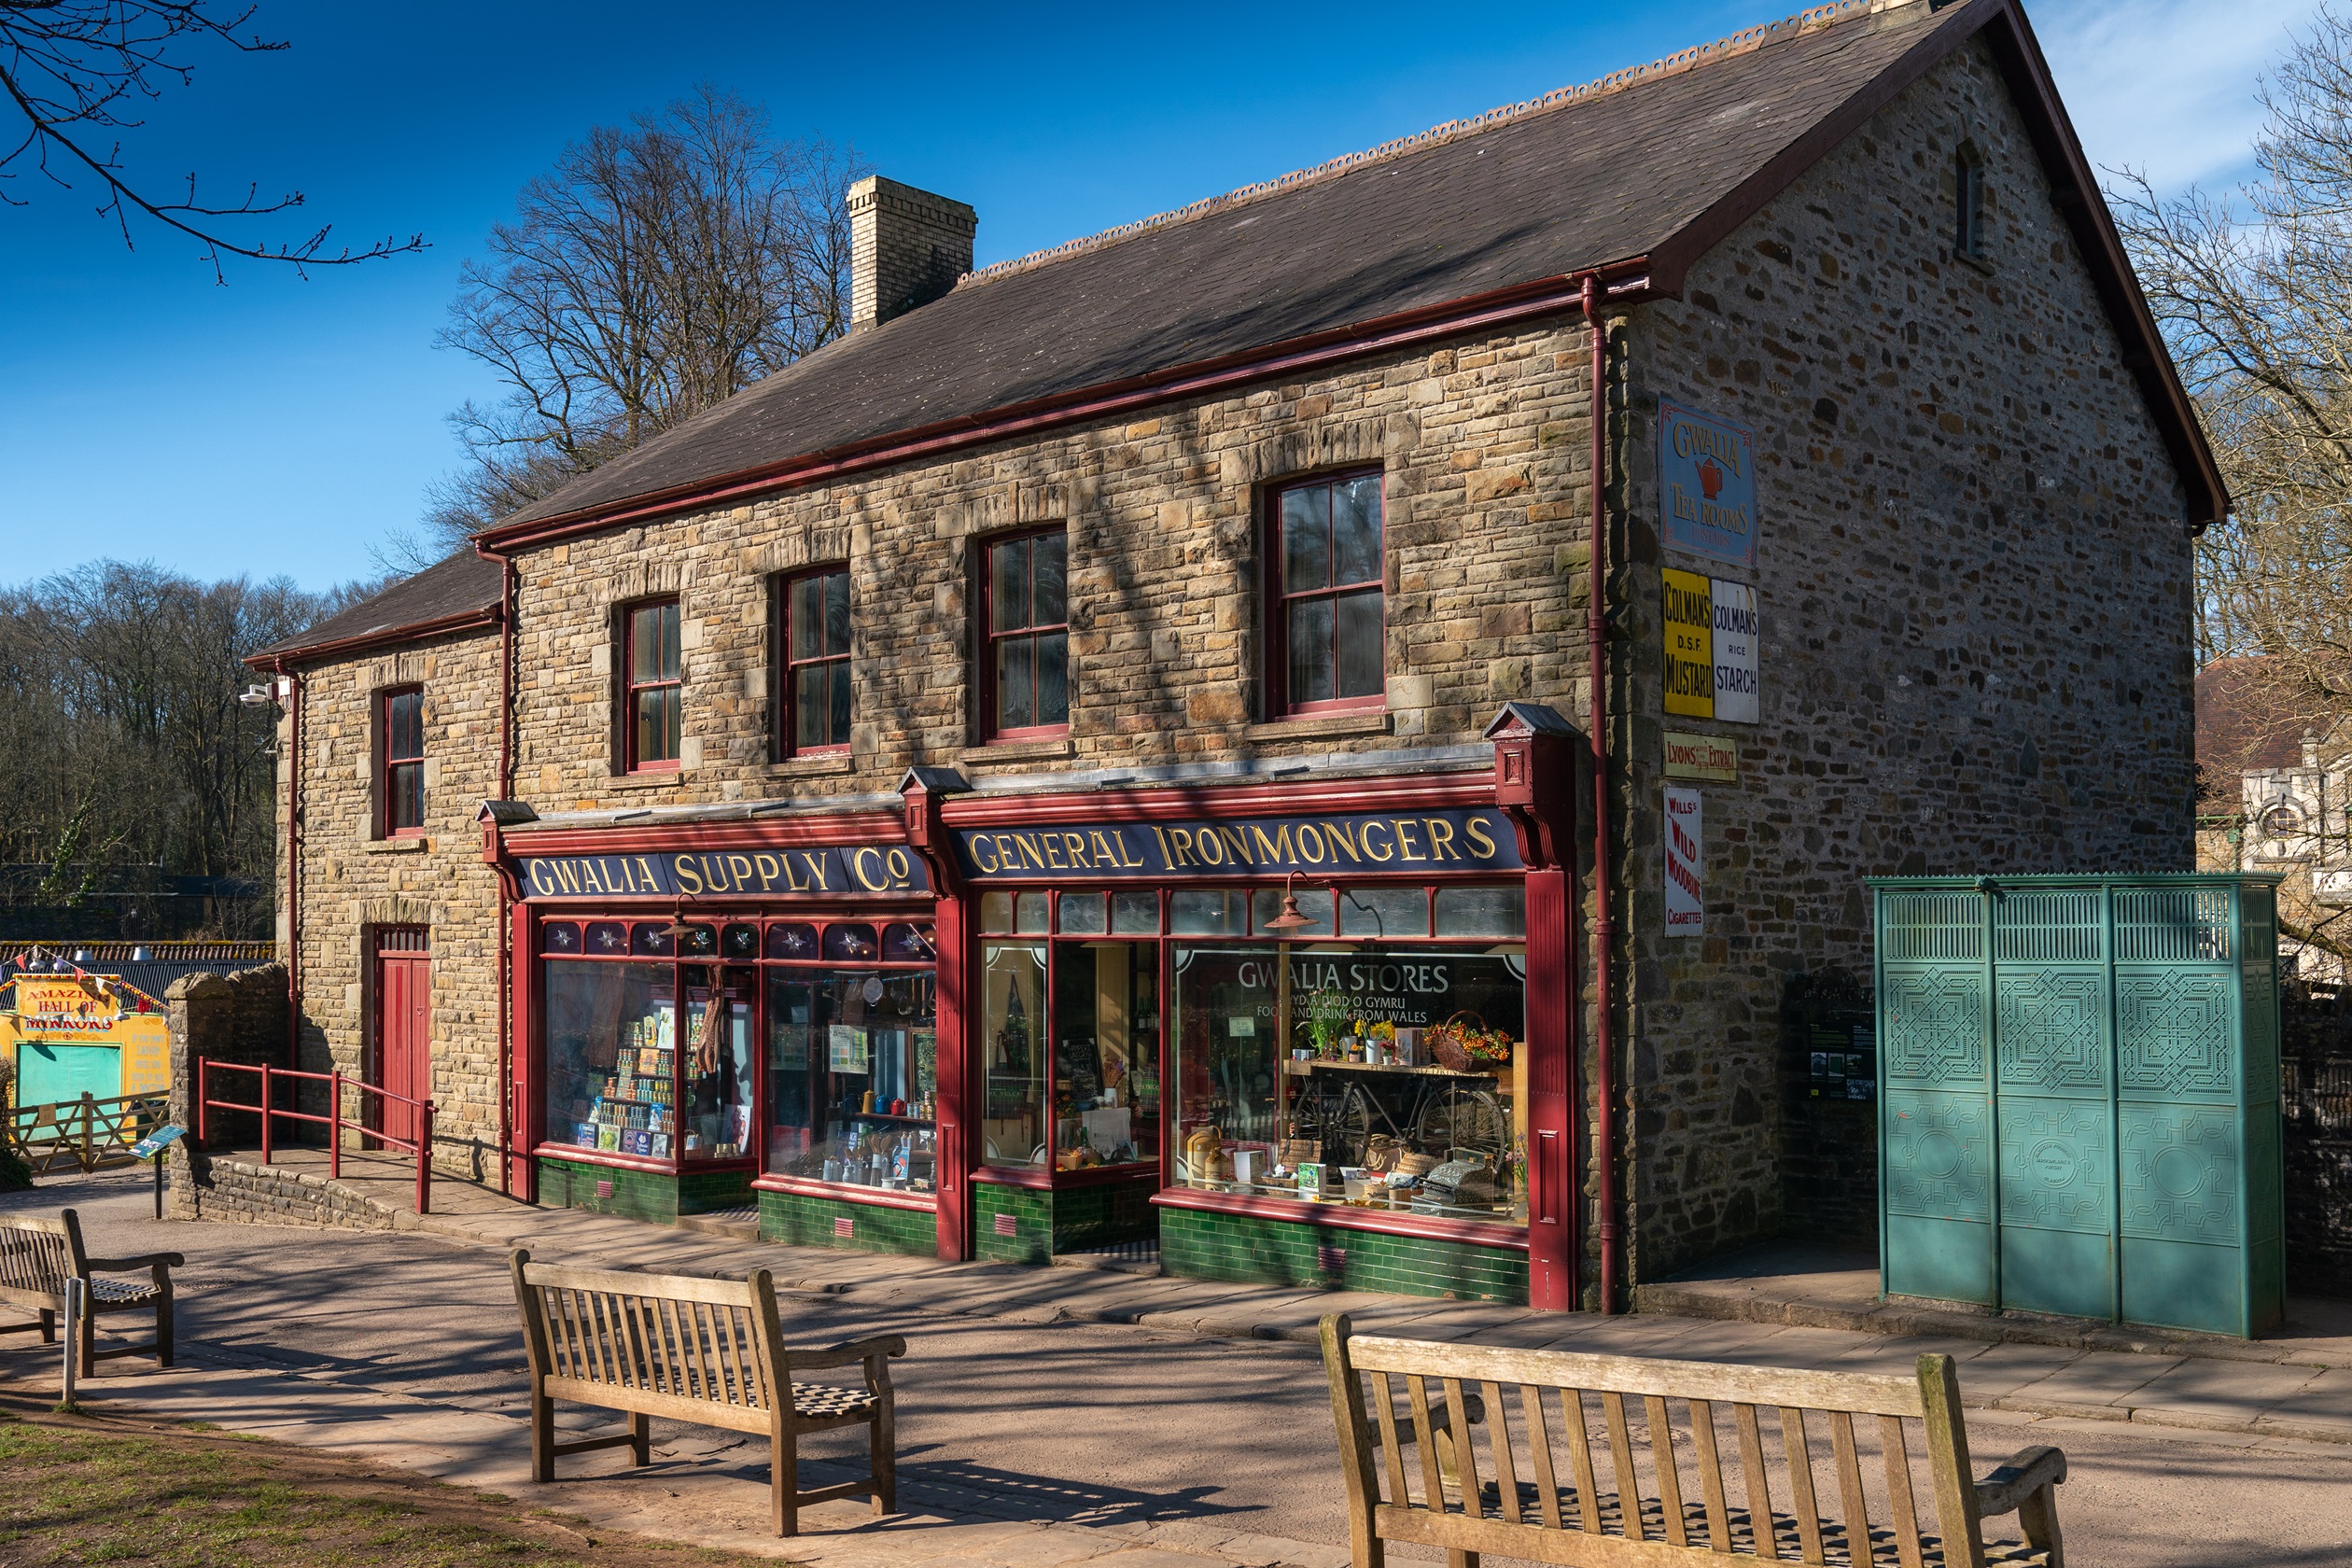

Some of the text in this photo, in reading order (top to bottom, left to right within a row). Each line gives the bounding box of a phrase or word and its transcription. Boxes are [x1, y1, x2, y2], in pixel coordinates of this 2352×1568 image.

[1673, 421, 1741, 479] GWALIA
[1670, 482, 1749, 536] TEA ROOMS
[1664, 581, 1710, 629] COLMAN'S
[1714, 605, 1757, 637] COLMAN'S
[1677, 635, 1702, 652] D.S.F.
[1729, 645, 1746, 656] RICE
[1665, 653, 1711, 699] MUSTARD
[1716, 665, 1757, 695] STARCH
[1708, 745, 1734, 768] EXTRACT
[968, 817, 1496, 874] GENERAL IRONMONGERS
[529, 857, 661, 896] GWALIA
[674, 853, 829, 895] SUPPLY
[1668, 908, 1702, 925] CIGARETTES
[1238, 962, 1449, 993] GWALIA STORES
[27, 989, 110, 1003] AMAZING
[38, 1001, 97, 1014] HALL OF
[1365, 997, 1406, 1009] GYMRU
[24, 1015, 113, 1032] MIRRORS
[1290, 1008, 1313, 1018] AND
[1317, 1008, 1349, 1019] DRINK
[1352, 1010, 1383, 1022] FROM
[1388, 1011, 1427, 1023] WALES
